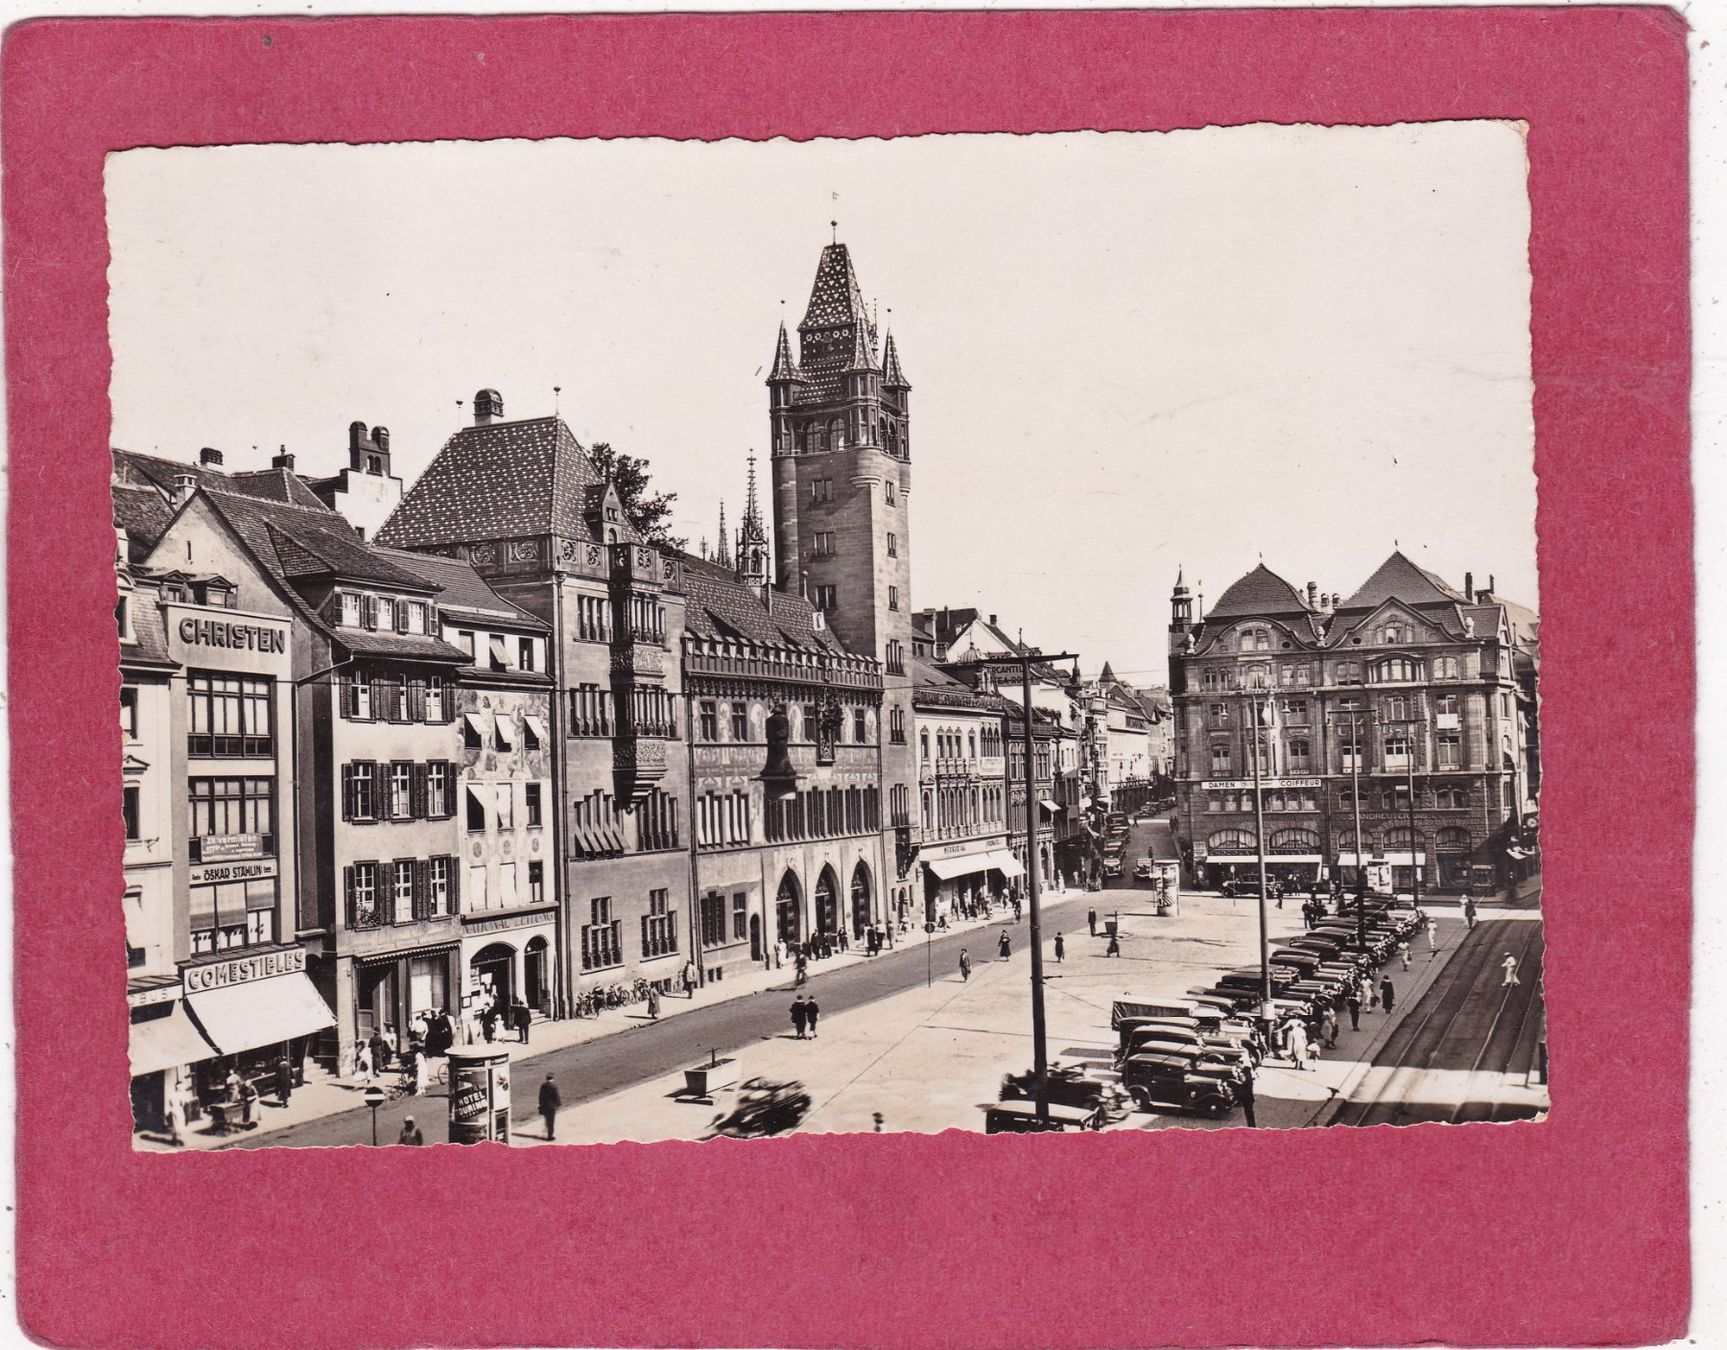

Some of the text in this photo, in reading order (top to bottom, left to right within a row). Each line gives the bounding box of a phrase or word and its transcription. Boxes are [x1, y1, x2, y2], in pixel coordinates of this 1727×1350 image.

[179, 617, 285, 654] CHRISTEN
[1279, 779, 1320, 788] COIFFEUR
[462, 912, 554, 934] NATIONAL ZEITUNG
[188, 951, 304, 990] COMESTIBLES
[458, 1090, 485, 1106] HOTEL
